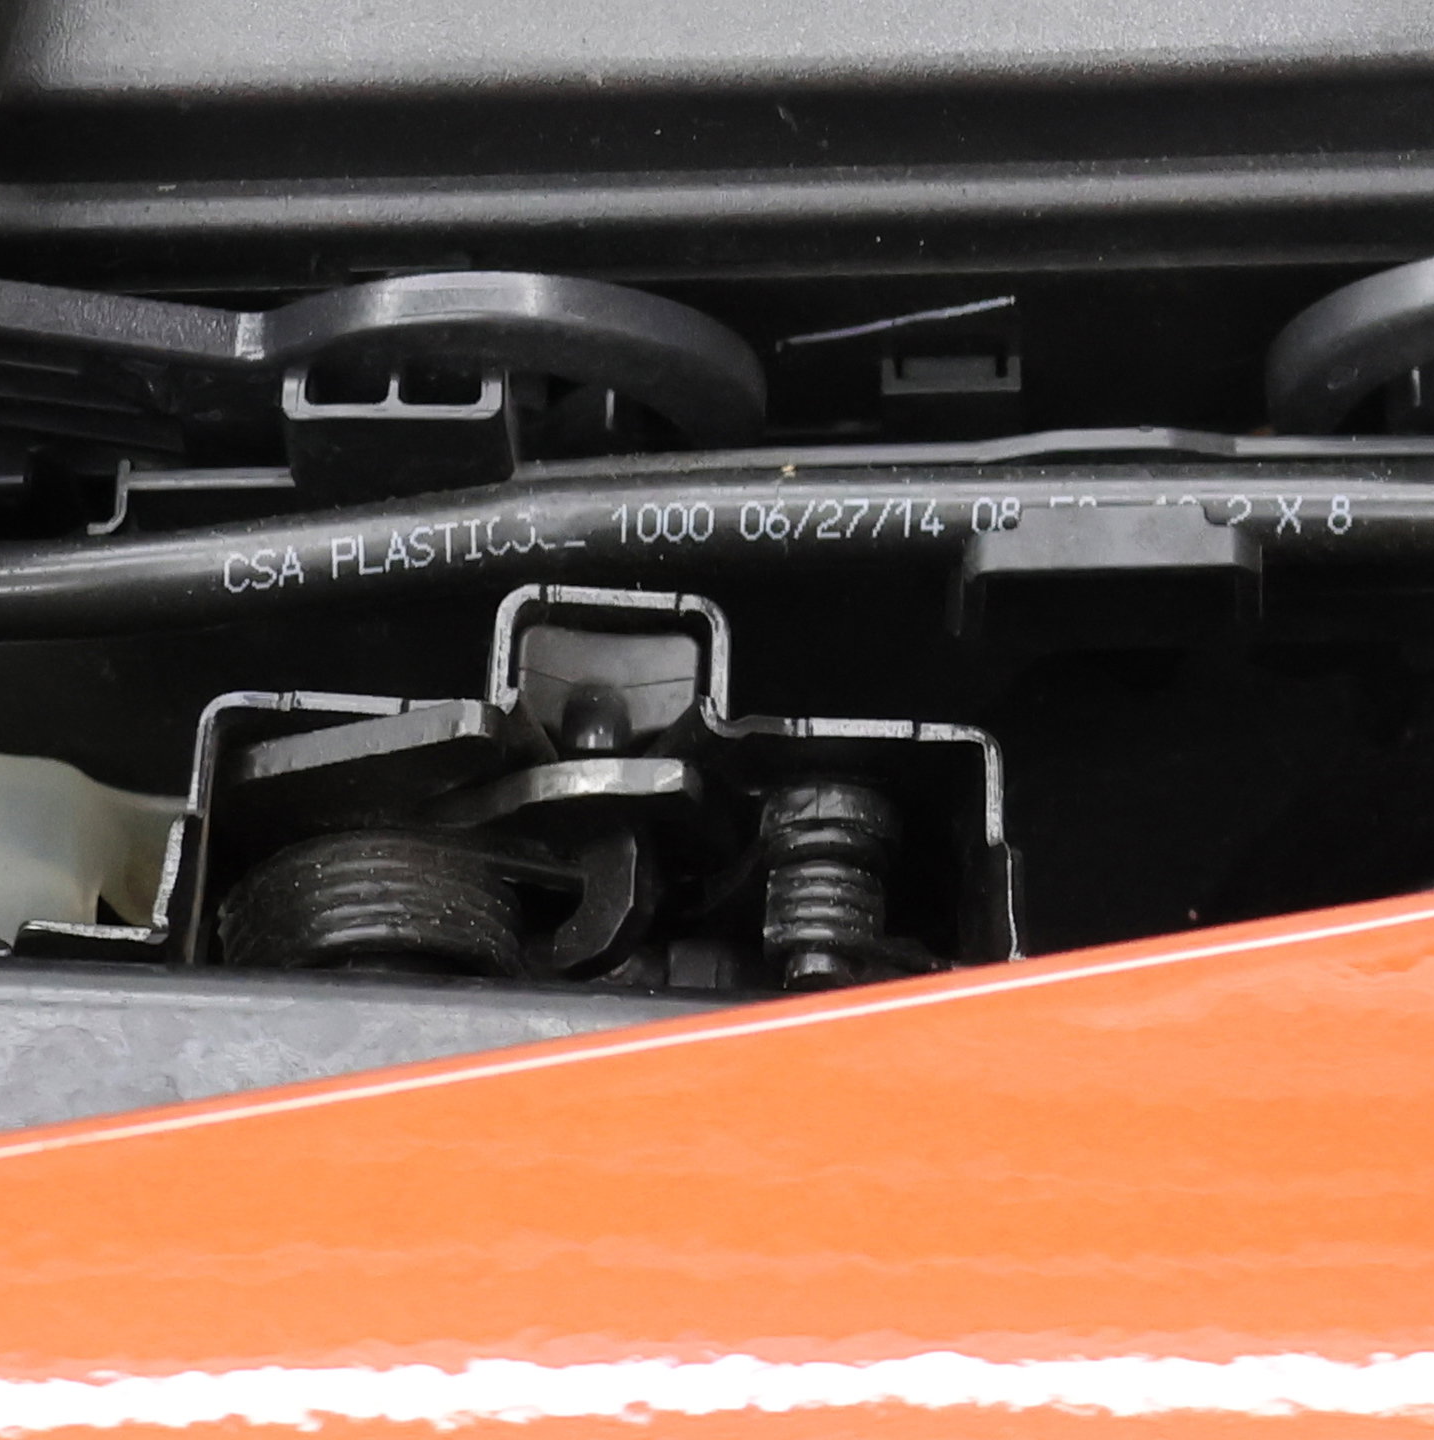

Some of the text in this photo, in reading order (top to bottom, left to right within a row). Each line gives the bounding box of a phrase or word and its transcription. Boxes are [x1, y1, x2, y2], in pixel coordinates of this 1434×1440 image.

[223, 544, 305, 593] CSA
[611, 502, 715, 544] 1000
[739, 498, 945, 541] 06/27/14
